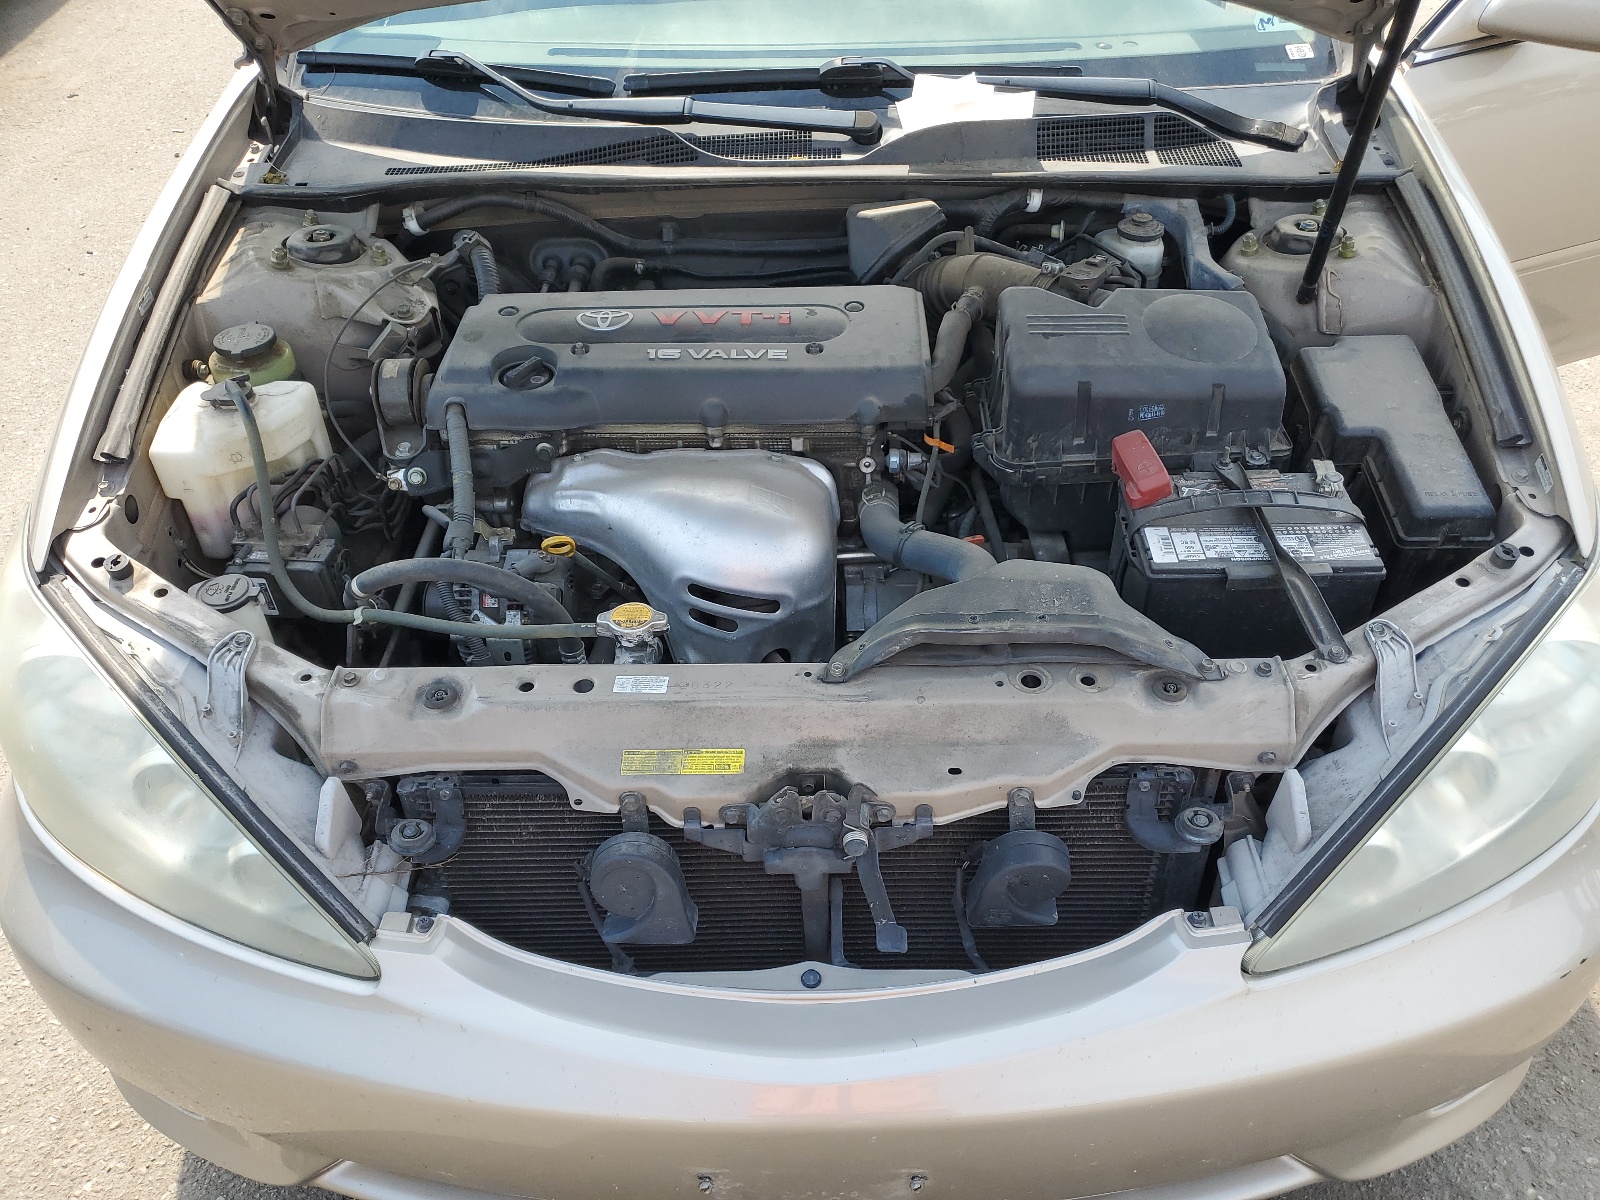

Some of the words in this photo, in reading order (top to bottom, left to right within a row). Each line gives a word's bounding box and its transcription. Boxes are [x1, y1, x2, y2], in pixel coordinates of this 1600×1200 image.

[651, 310, 791, 325] VVT-i
[647, 348, 682, 360] 16
[686, 348, 788, 360] VALVE
